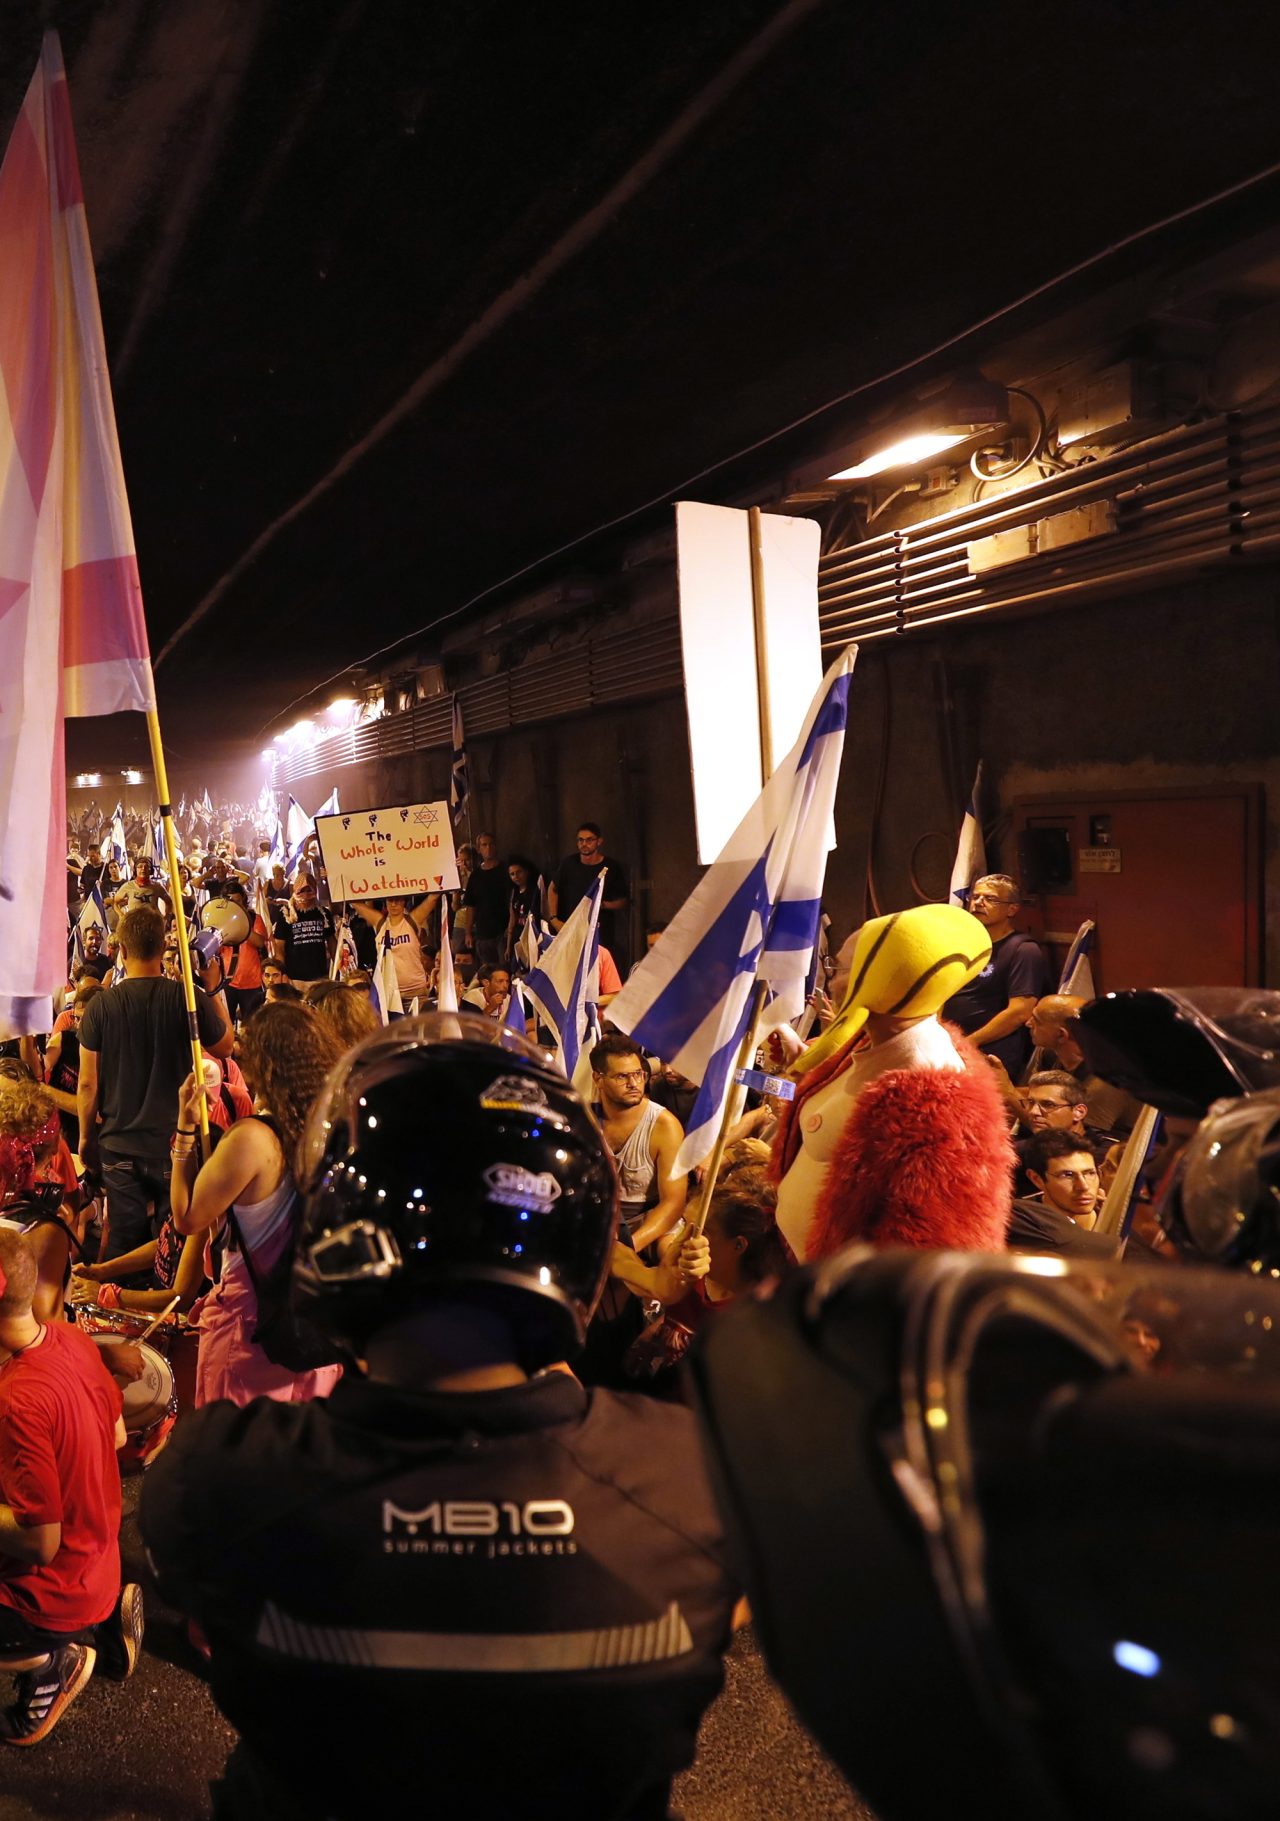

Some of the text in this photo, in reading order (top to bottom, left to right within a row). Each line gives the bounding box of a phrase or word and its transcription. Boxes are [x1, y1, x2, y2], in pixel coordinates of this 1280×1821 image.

[365, 831, 392, 842] The
[340, 834, 440, 860] Whole World
[374, 856, 386, 867] is
[383, 1499, 575, 1536] MB10
[383, 1539, 577, 1559] summer jackets
